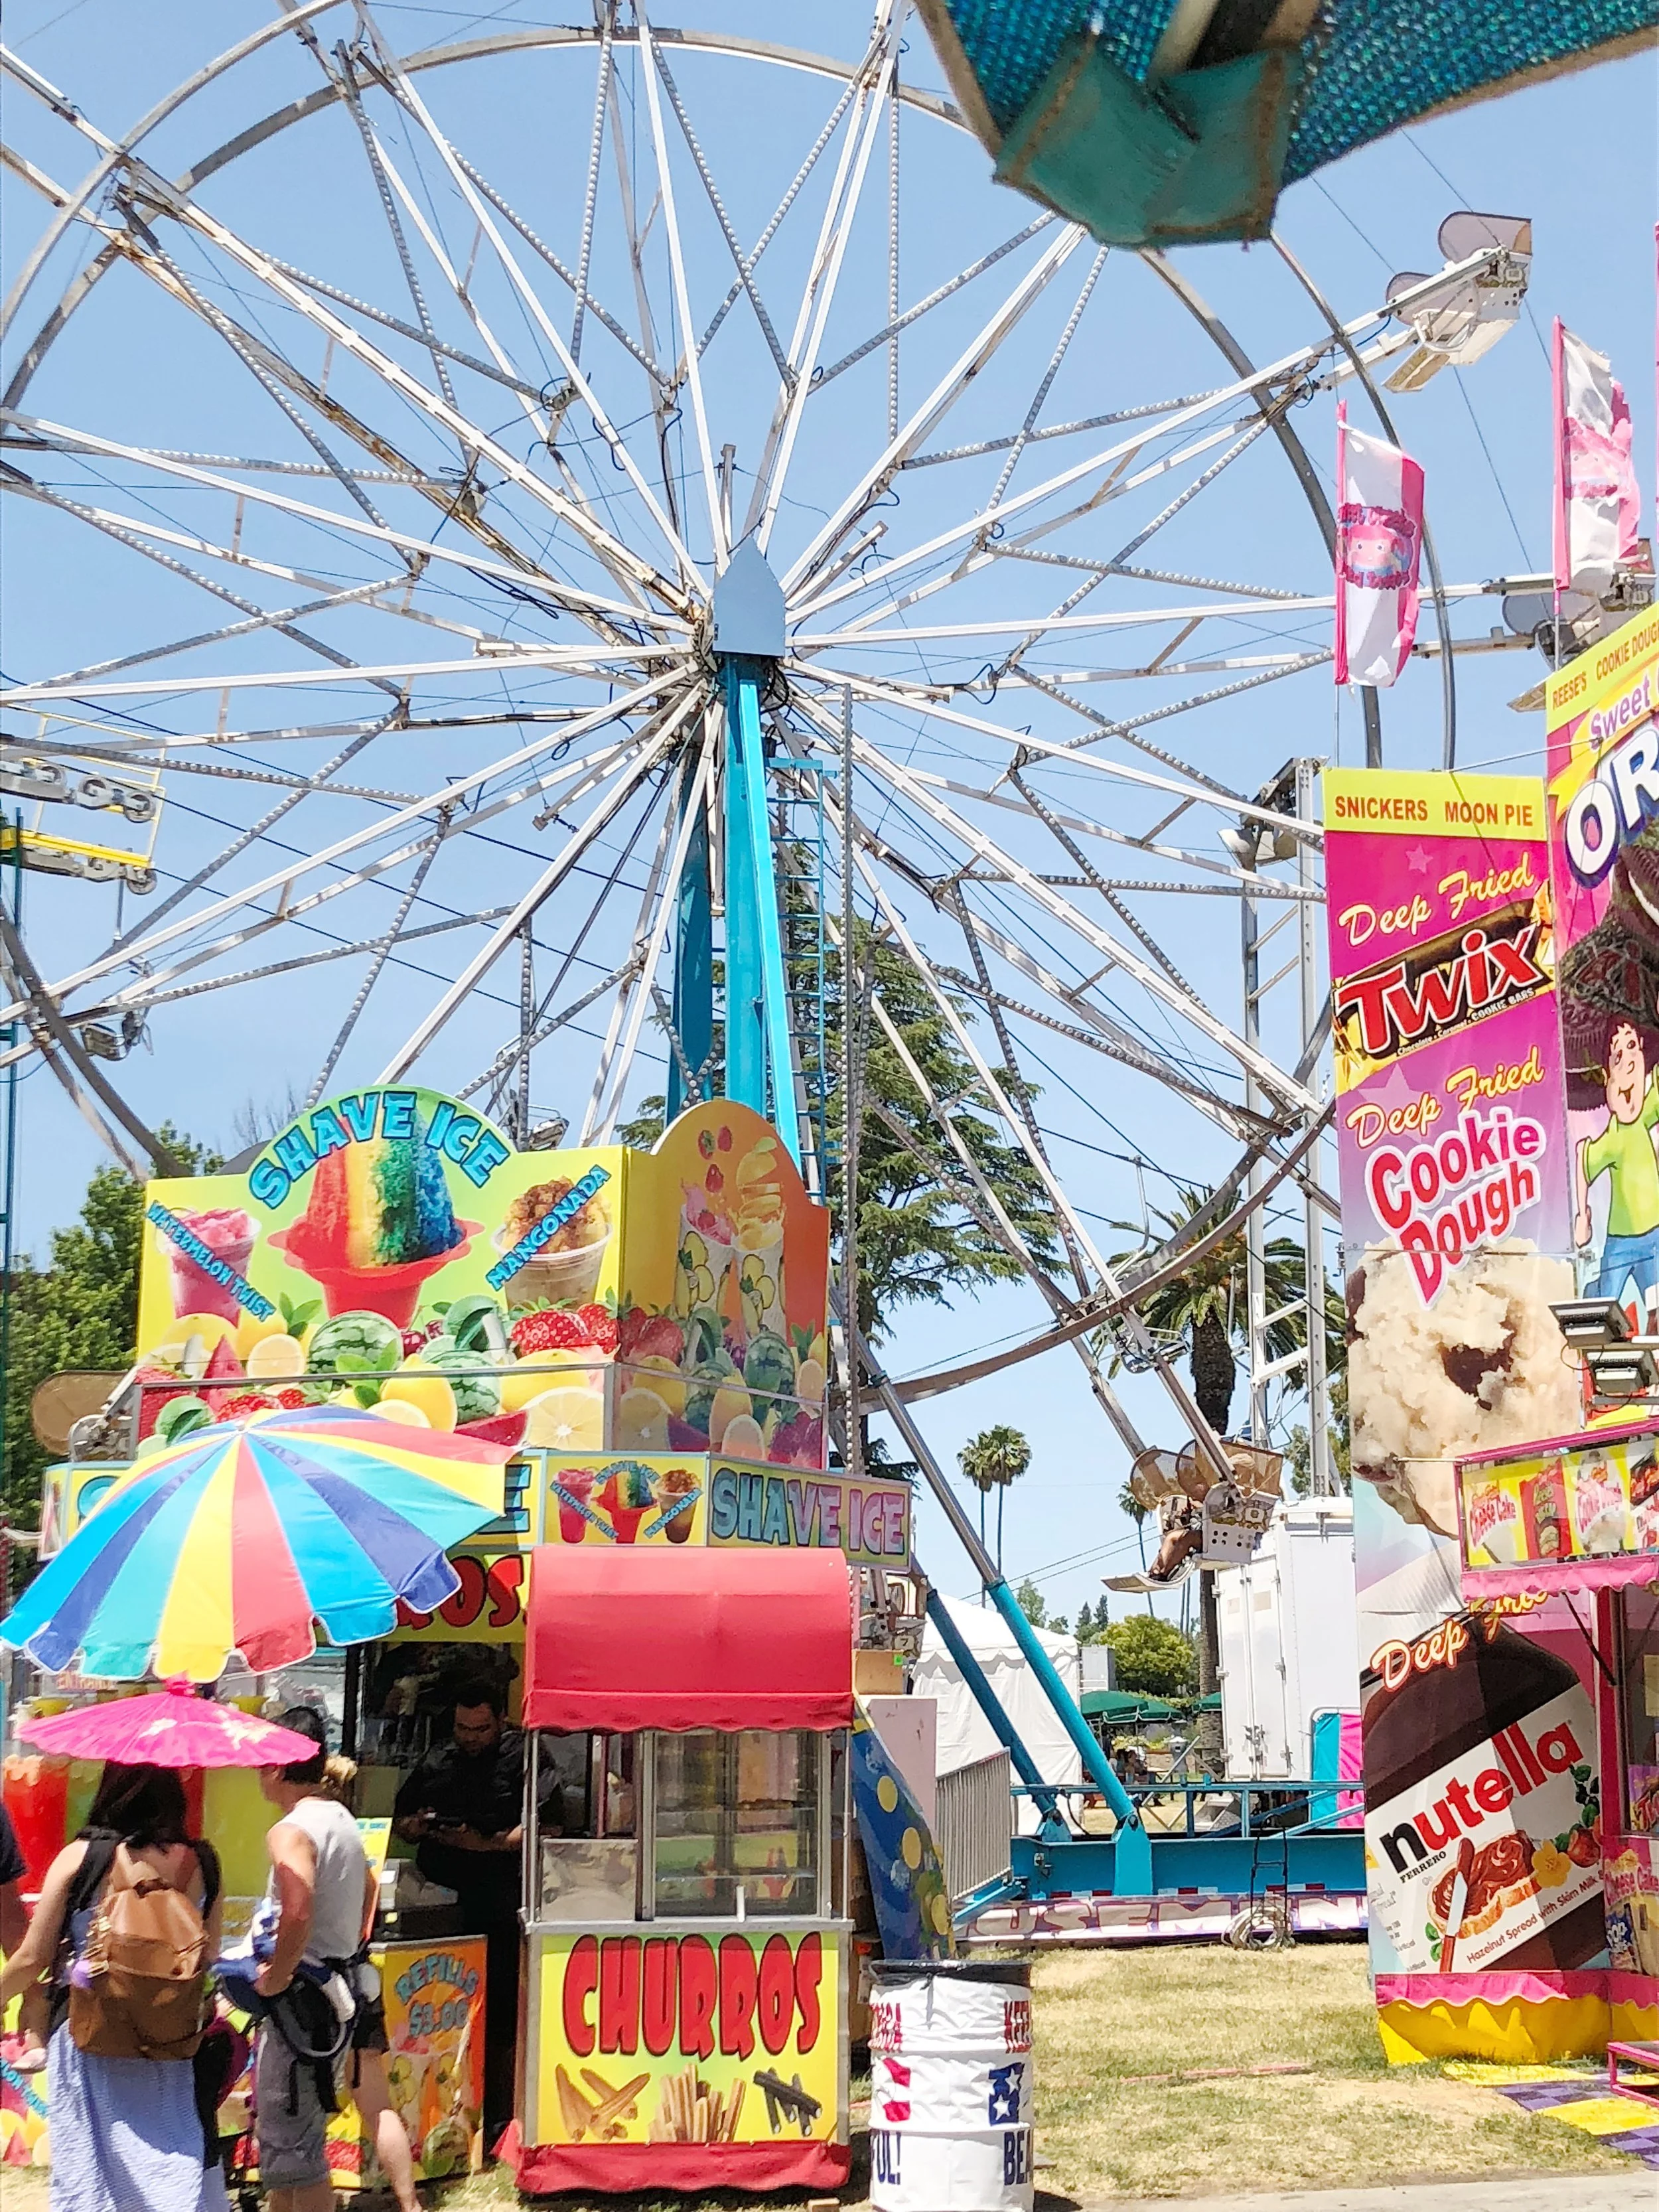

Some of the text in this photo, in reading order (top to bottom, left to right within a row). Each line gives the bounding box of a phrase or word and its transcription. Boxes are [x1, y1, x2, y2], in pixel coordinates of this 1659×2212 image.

[1552, 671, 1587, 711] REESE'S
[1596, 619, 1659, 681] COOKIE DOUG
[1590, 674, 1650, 751] Sweet
[1335, 796, 1428, 822] SNICKERS
[1445, 800, 1534, 827] MOON PIE
[1337, 851, 1535, 946] Deep Fried
[1334, 921, 1544, 1054] Twix
[1471, 999, 1508, 1021] COOKIE
[1508, 987, 1536, 1005] BARS
[1346, 1045, 1545, 1149] Deep Fried
[249, 1090, 511, 1210] SHAVE ICE
[1369, 1112, 1542, 1230] Cookie
[145, 1199, 277, 1323] WATERMELON TWIST
[485, 1164, 613, 1291] MANGONADA
[1399, 1161, 1536, 1305] Dough
[711, 1467, 906, 1555] SHAVE ICE
[900, 1637, 909, 1647] 7
[1370, 1619, 1469, 1691] Deep
[1378, 1721, 1584, 1874] nutella
[1400, 1850, 1447, 1883] FERRERO
[1467, 1935, 1506, 1964] Hazelnut
[1506, 1913, 1538, 1939] Spread
[1538, 1900, 1558, 1919] with
[1557, 1889, 1580, 1907] Skim
[1579, 1876, 1599, 1892] Milk
[394, 1953, 479, 2006] REFILLS
[408, 1997, 470, 2039] $3.00
[563, 1931, 822, 2062] CHURROS
